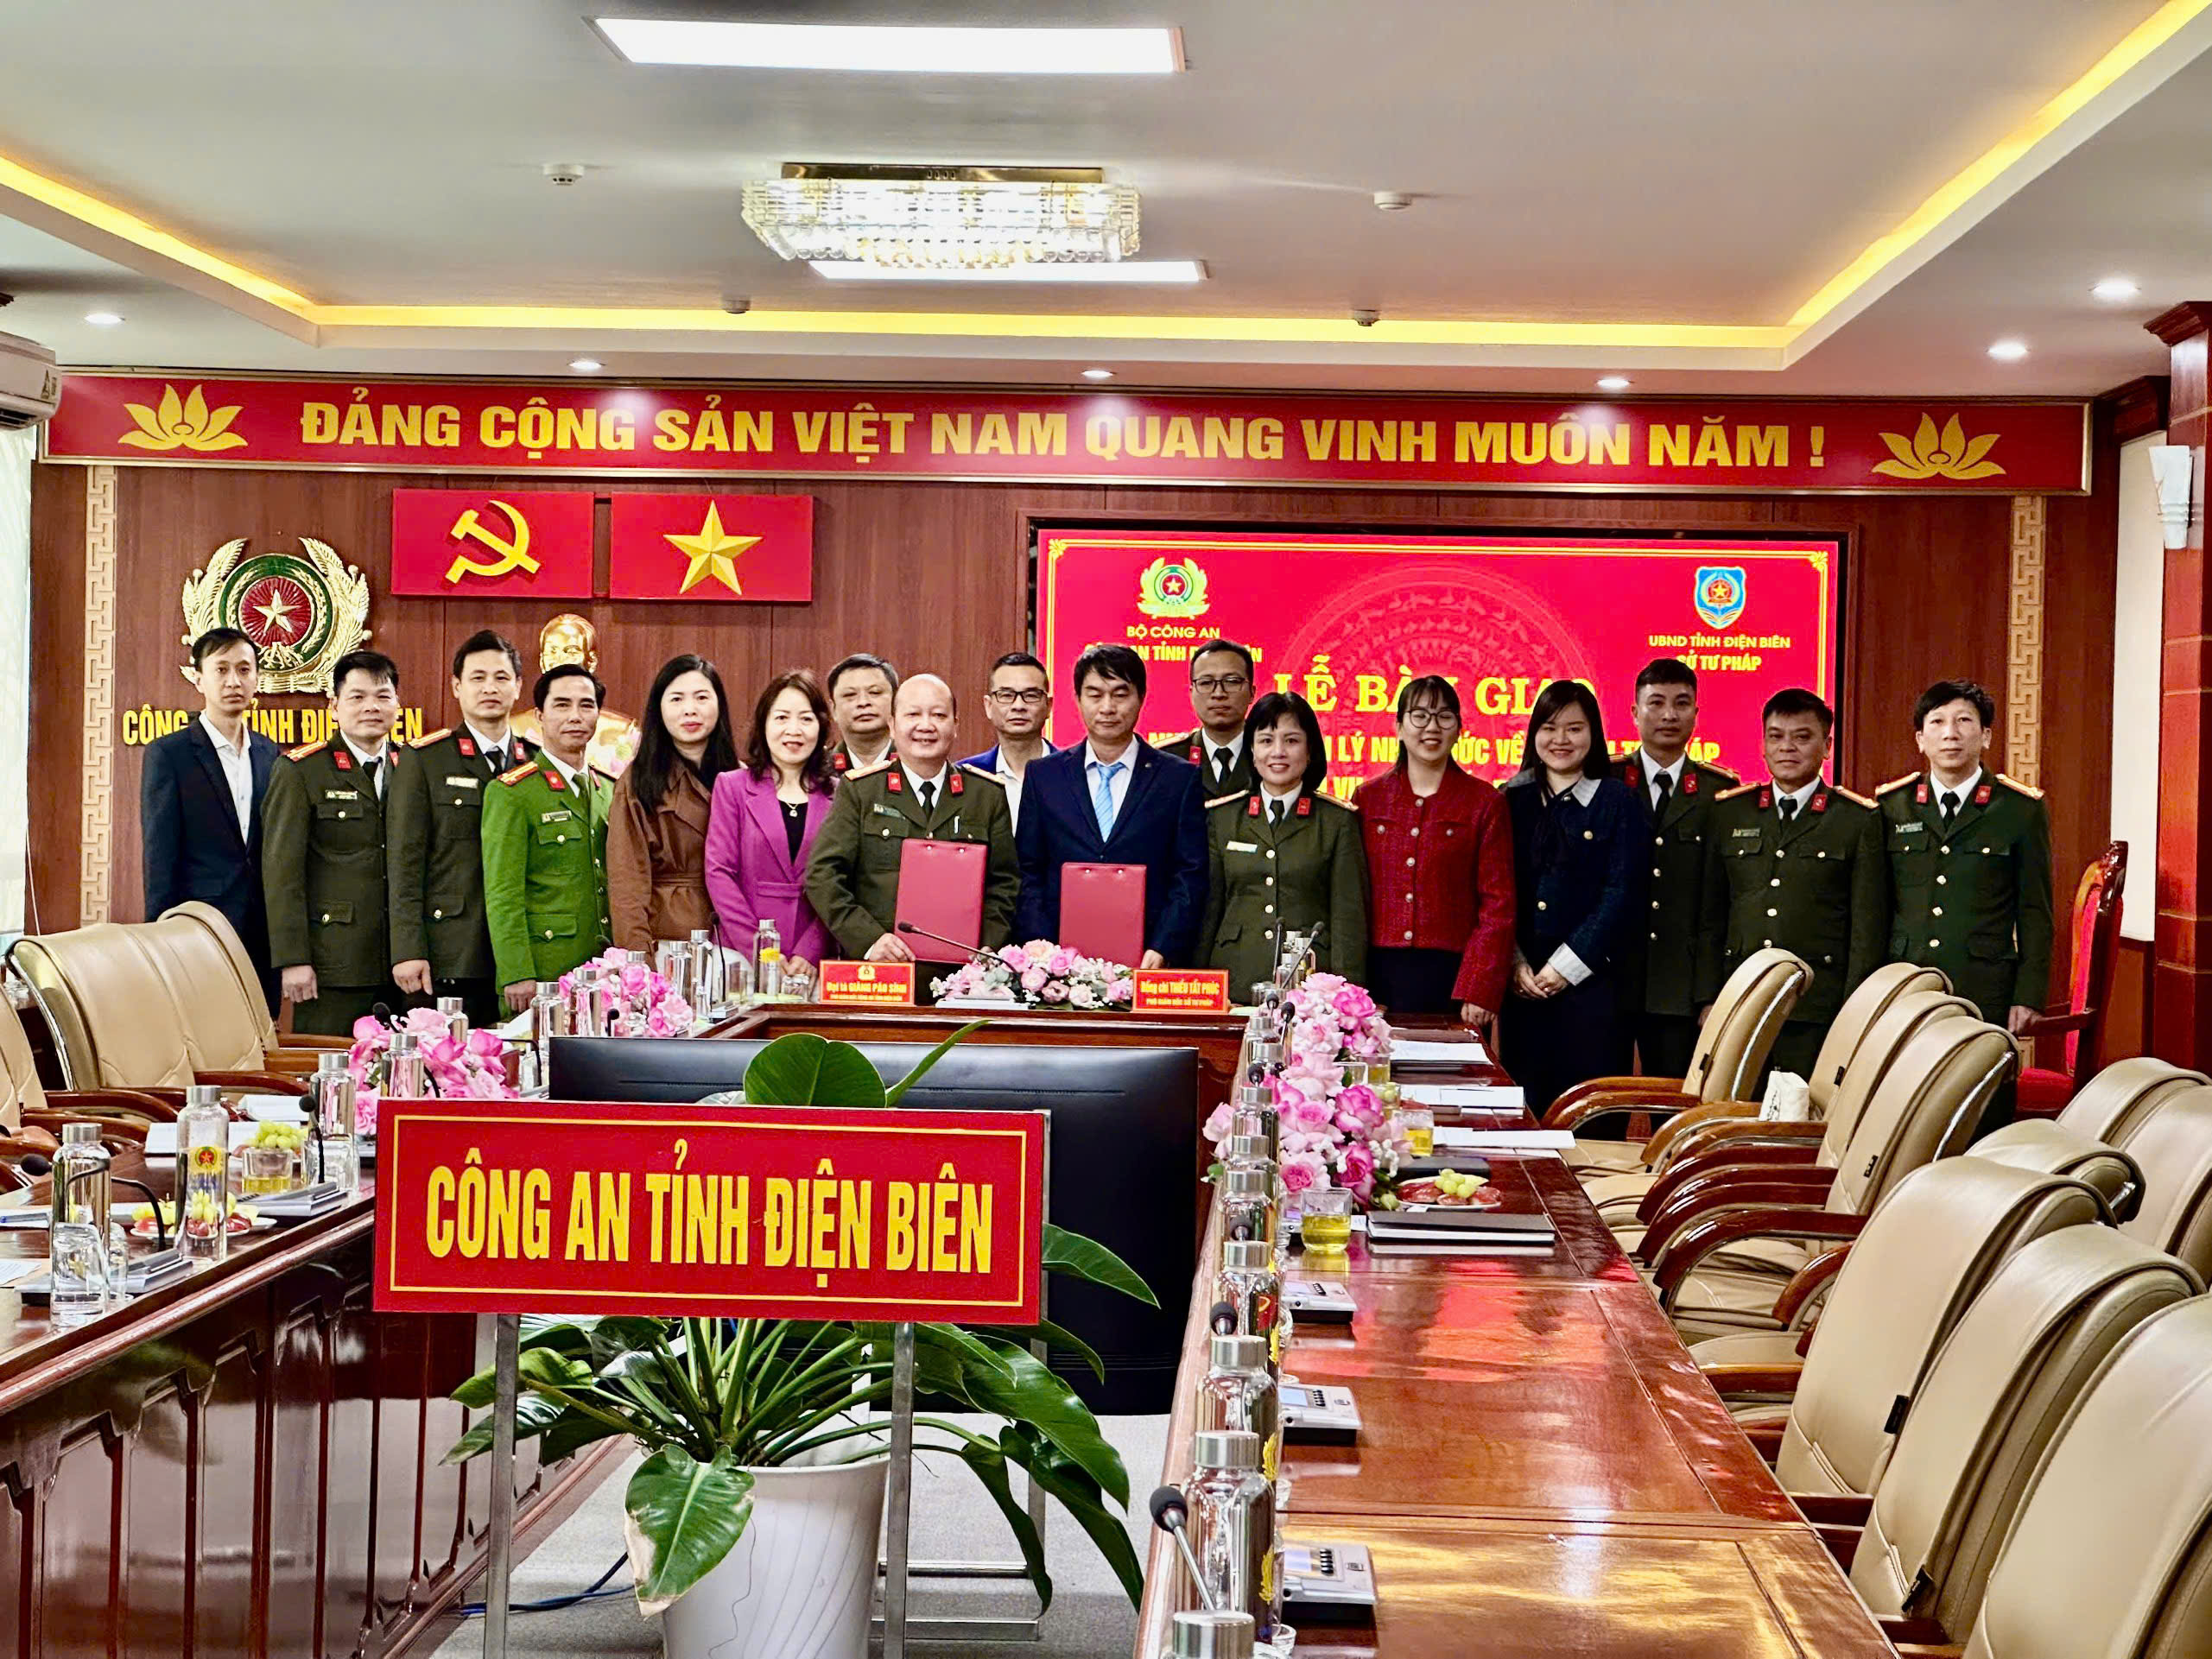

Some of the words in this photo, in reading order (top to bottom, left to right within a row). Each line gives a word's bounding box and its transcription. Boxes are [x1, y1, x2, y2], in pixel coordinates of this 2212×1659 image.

[301, 388, 461, 447] ĐẢNG
[480, 397, 636, 459] CỘNG
[653, 395, 773, 453] SẢN
[792, 402, 915, 464] VIỆT
[930, 412, 1068, 456] NAM
[1085, 415, 1283, 461] QUANG
[1302, 420, 1436, 462] VINH
[1455, 414, 1631, 466] MUÔN
[1648, 416, 1789, 467] NĂM
[1126, 624, 1148, 640] BỘ
[1150, 624, 1196, 639] CÔNG
[1198, 627, 1220, 639] AN
[1649, 635, 1688, 647] UBND
[1689, 632, 1721, 648] TỈNH
[1723, 634, 1757, 650] ĐIỆN
[1759, 635, 1791, 649] BIÊN
[1152, 641, 1187, 662] TỈNH
[1700, 655, 1721, 671] TƯ
[1721, 653, 1762, 671] PHÁP
[1354, 664, 1459, 712] BÀ
[1475, 676, 1596, 715] GI
[1338, 731, 1366, 762] LÝ
[426, 1147, 551, 1260] CÔNG
[564, 1171, 631, 1262] AN
[645, 1138, 750, 1265] TỈNH
[763, 1158, 872, 1289] ĐIỆN
[886, 1162, 993, 1274] BIÊN
